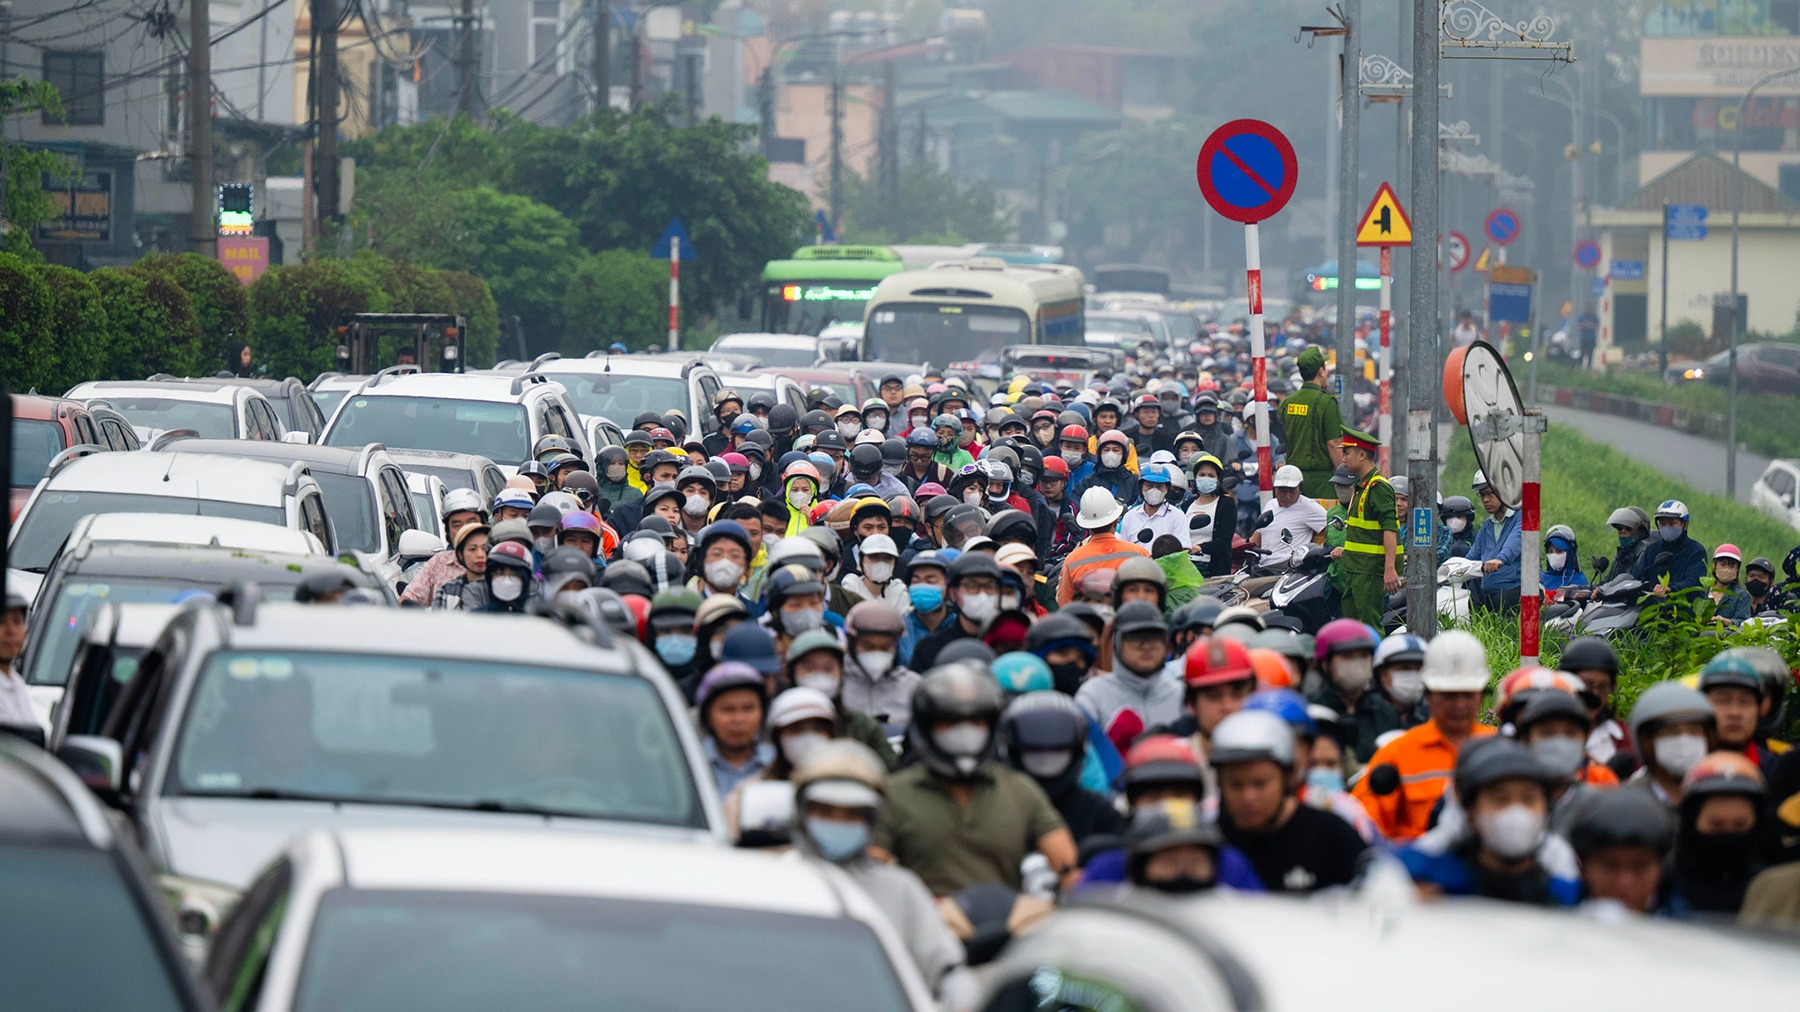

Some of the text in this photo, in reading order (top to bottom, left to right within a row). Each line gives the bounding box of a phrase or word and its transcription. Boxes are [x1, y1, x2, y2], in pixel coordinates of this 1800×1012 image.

[225, 247, 261, 260] NAIL
[1288, 404, 1307, 414] CS 113
[1420, 509, 1426, 517] A
